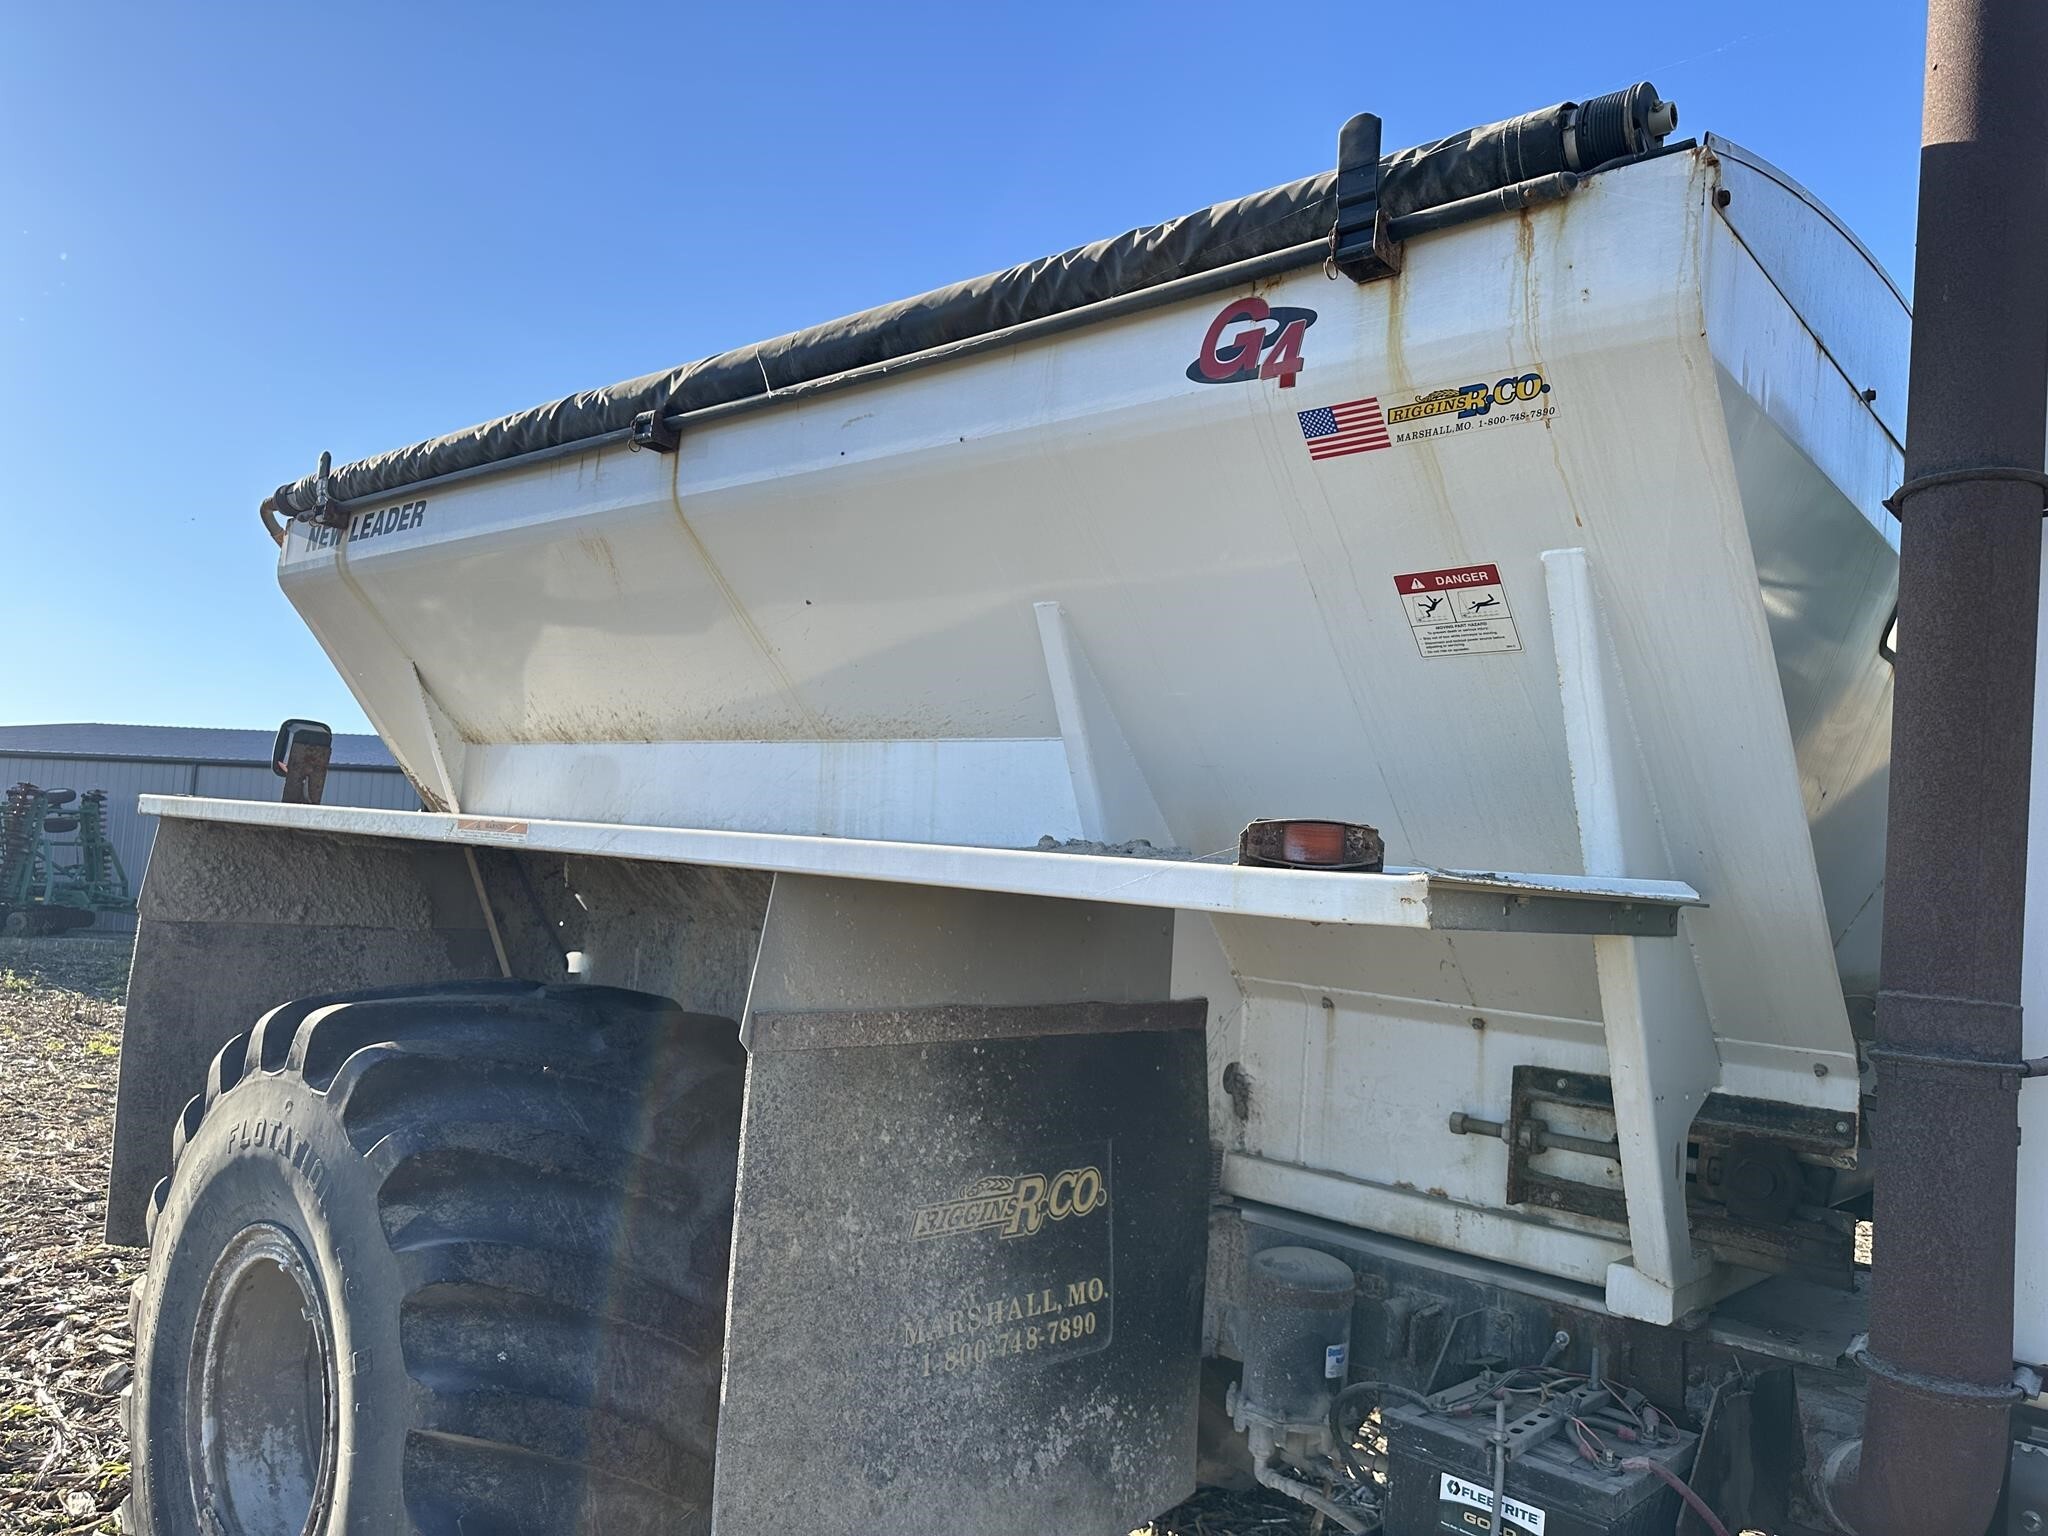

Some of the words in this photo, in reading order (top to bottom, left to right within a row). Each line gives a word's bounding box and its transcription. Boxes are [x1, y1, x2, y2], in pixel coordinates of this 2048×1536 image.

[1199, 297, 1304, 388] G4
[1392, 396, 1467, 422] RIGGINS
[1478, 406, 1556, 428] 1-800-748-7890
[348, 500, 427, 543] LEADER
[1435, 571, 1489, 586] DANGER
[917, 1196, 1020, 1233] RIGGINS
[1461, 1486, 1538, 1525] FLEERITE
[1463, 1511, 1517, 1536] GOD
